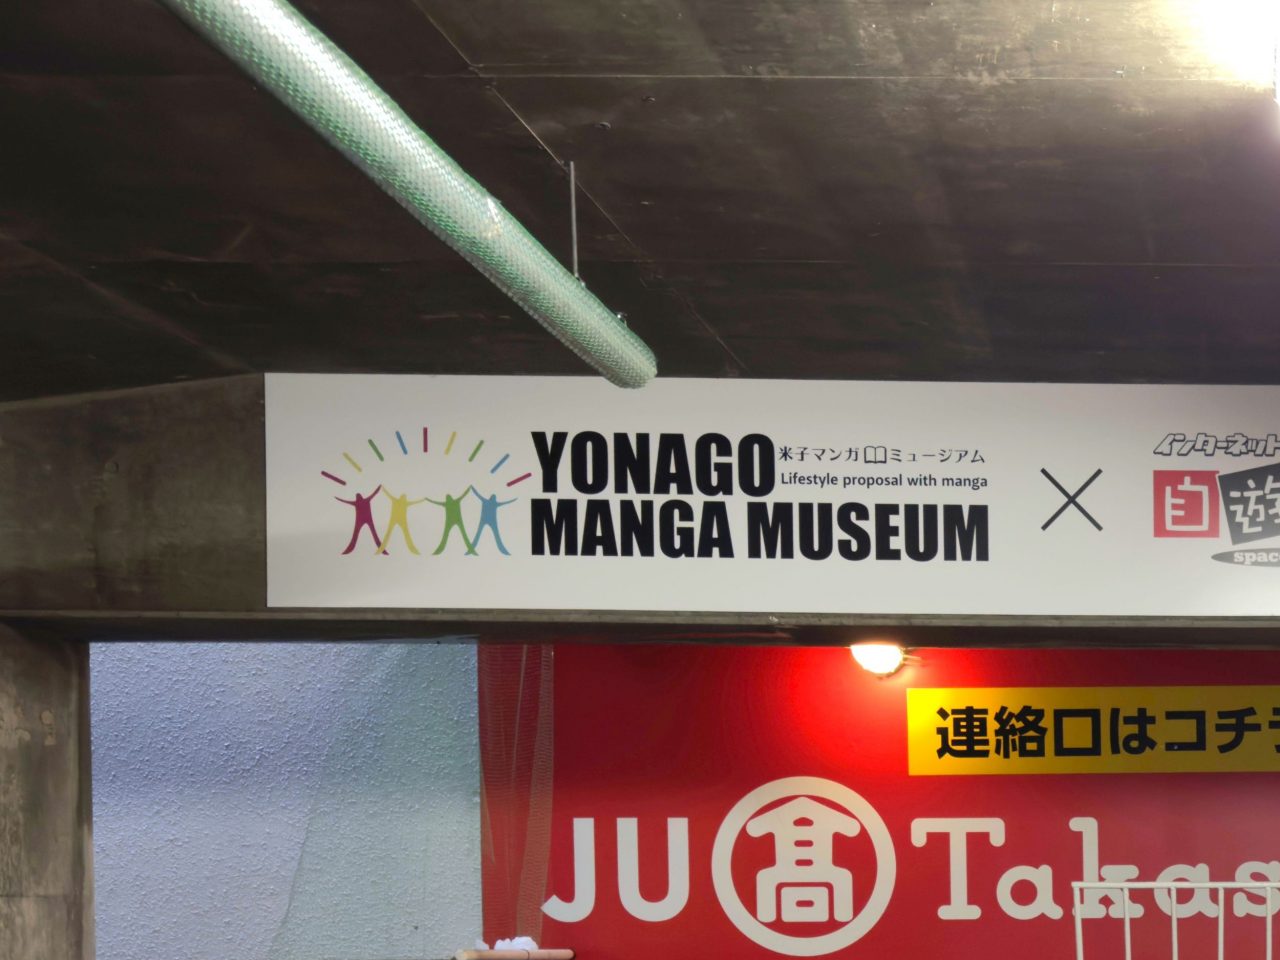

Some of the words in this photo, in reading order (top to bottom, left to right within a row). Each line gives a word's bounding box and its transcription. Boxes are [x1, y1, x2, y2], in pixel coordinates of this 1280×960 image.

[531, 430, 776, 498] YONAGO
[781, 472, 838, 488] Lifestyle
[843, 474, 903, 489] proposal
[907, 474, 937, 487] with
[942, 476, 988, 490] manga
[531, 499, 734, 559] MANGA
[747, 501, 990, 562] MUSEUM
[541, 816, 691, 923] JU
